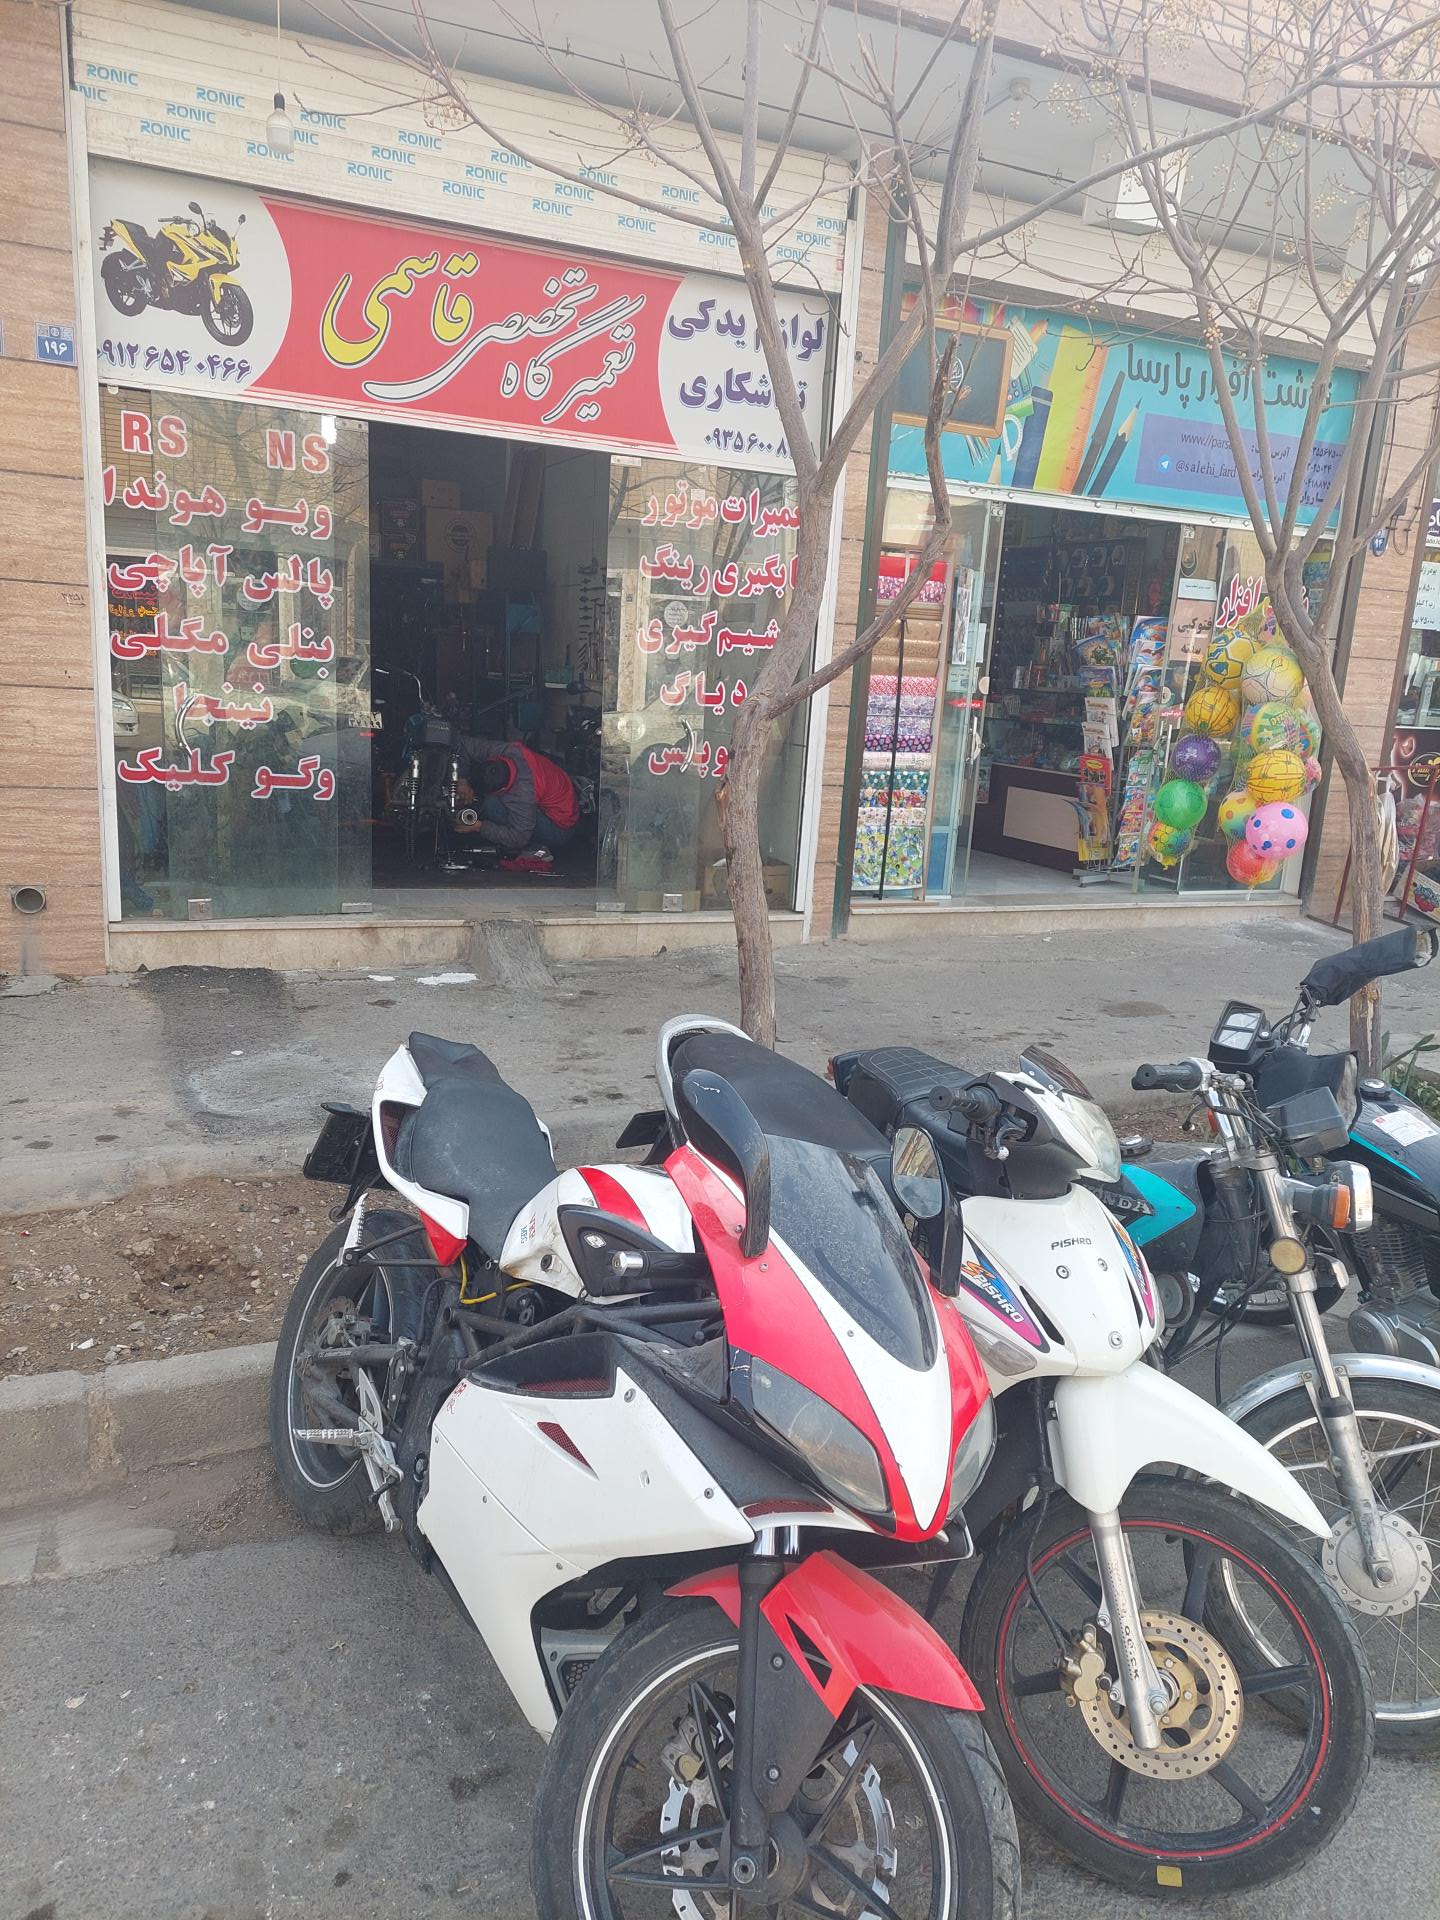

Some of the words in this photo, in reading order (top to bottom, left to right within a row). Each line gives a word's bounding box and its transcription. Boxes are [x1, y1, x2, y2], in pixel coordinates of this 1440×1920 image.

[86, 64, 138, 86] RONIC
[77, 84, 107, 102] NIC
[196, 87, 246, 109] RONIC
[166, 103, 217, 124] RONIC
[300, 110, 347, 130] RONIC
[140, 120, 191, 142] RONIC
[293, 129, 319, 145] NIC
[398, 130, 443, 150] RONIC
[372, 146, 416, 165] RONIC
[347, 162, 393, 182] RONIC
[465, 165, 508, 184] RONIC
[442, 181, 485, 200] RONIC
[554, 183, 595, 201] RONIC
[661, 185, 700, 203] RONIC
[532, 199, 573, 217] RONIC
[759, 205, 778, 218] NIC
[617, 215, 656, 233] RONIC
[699, 231, 736, 248] RONIC
[796, 231, 832, 248] RONIC
[776, 247, 812, 263] RONIC
[320, 252, 479, 368] قاسمی
[668, 299, 747, 347] یدکی
[44, 341, 68, 356] ۱۹۶
[502, 295, 645, 422] تعمیرگاه
[1127, 343, 1192, 409] پارسا
[679, 367, 808, 411] تشکاری
[120, 410, 187, 457] RS
[266, 429, 329, 474] NS
[1175, 459, 1238, 479] @salehi_fard
[102, 465, 226, 526] هوندا
[641, 479, 718, 528] موتور
[720, 487, 800, 537] عمیرات
[108, 543, 233, 598] آپاچی
[639, 543, 710, 595] رینگ
[713, 553, 799, 598] ابگیری
[243, 554, 334, 609] پالس
[1215, 573, 1263, 629] افزار
[110, 612, 229, 660] مگلی
[247, 622, 334, 679] بنلی
[117, 748, 235, 791] کلیک
[251, 755, 336, 800] وگو
[1090, 1184, 1153, 1215] ONDA
[1050, 1237, 1092, 1250] PISHRO
[975, 1273, 1025, 1324] PISHRO
